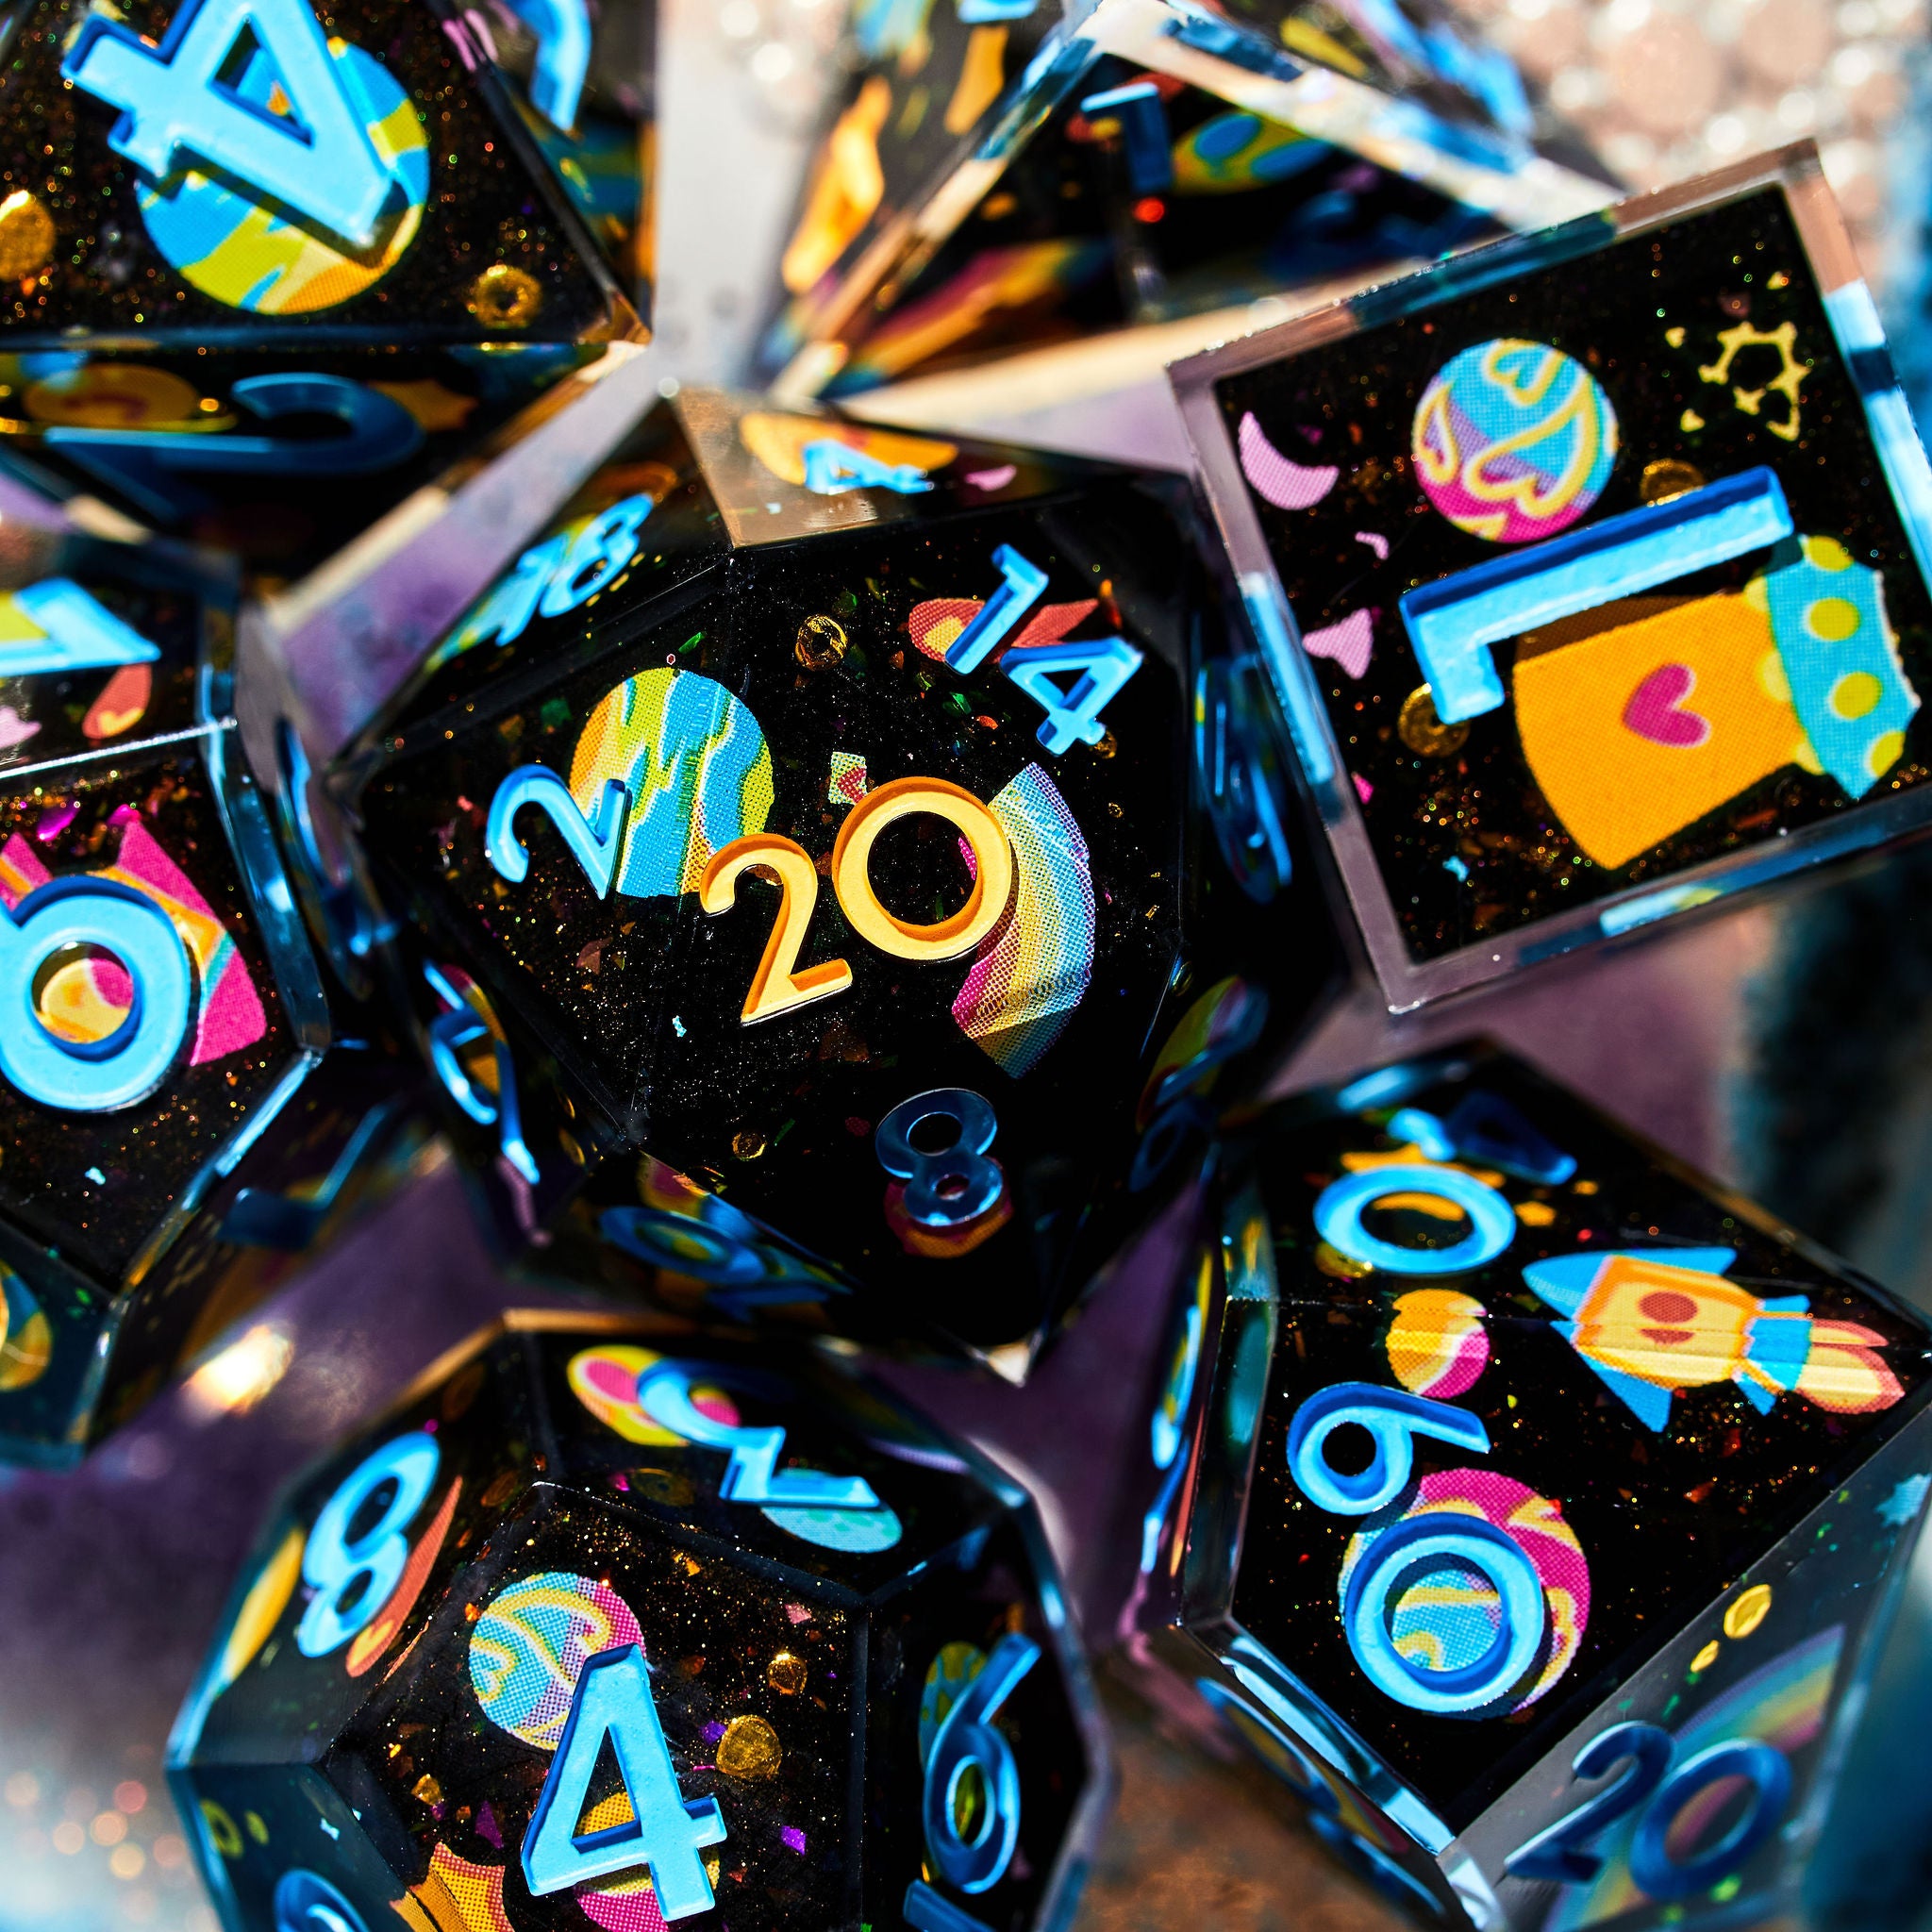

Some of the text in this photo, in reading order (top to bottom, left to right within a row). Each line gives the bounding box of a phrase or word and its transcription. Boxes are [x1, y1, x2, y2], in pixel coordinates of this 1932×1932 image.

[944, 543, 1142, 755] 14
[1399, 463, 1794, 723] 1
[485, 764, 631, 901] 2
[699, 776, 1013, 1026] 20
[874, 1087, 1000, 1227] 8
[296, 1430, 441, 1660] 8
[520, 1641, 727, 1923] 4
[922, 1632, 1041, 1895] 6
[1502, 1717, 1790, 1900] 20
